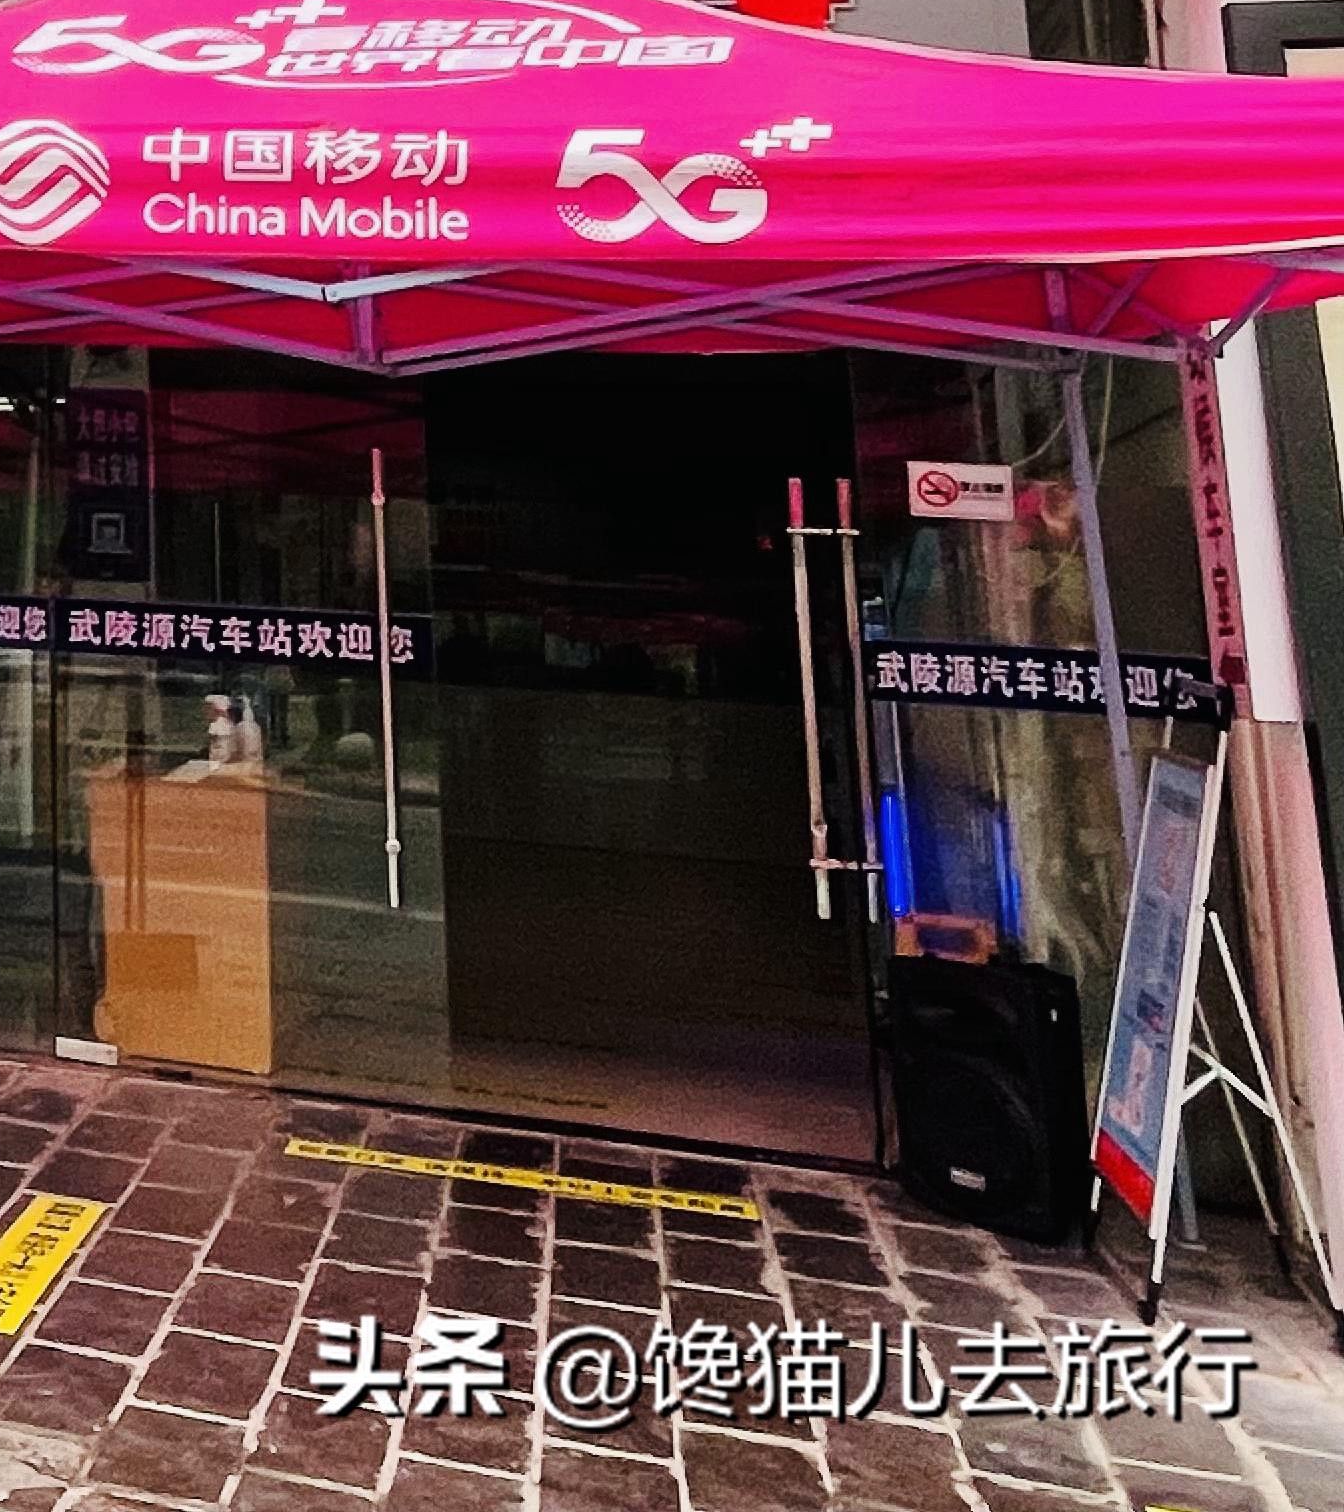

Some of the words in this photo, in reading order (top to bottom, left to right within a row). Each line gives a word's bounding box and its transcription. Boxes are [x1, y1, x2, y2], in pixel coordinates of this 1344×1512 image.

[141, 126, 470, 186] 中国移动
[141, 191, 286, 240] China
[298, 191, 470, 242] Mobile
[68, 608, 414, 664] 武陵源汽车站欢迎您
